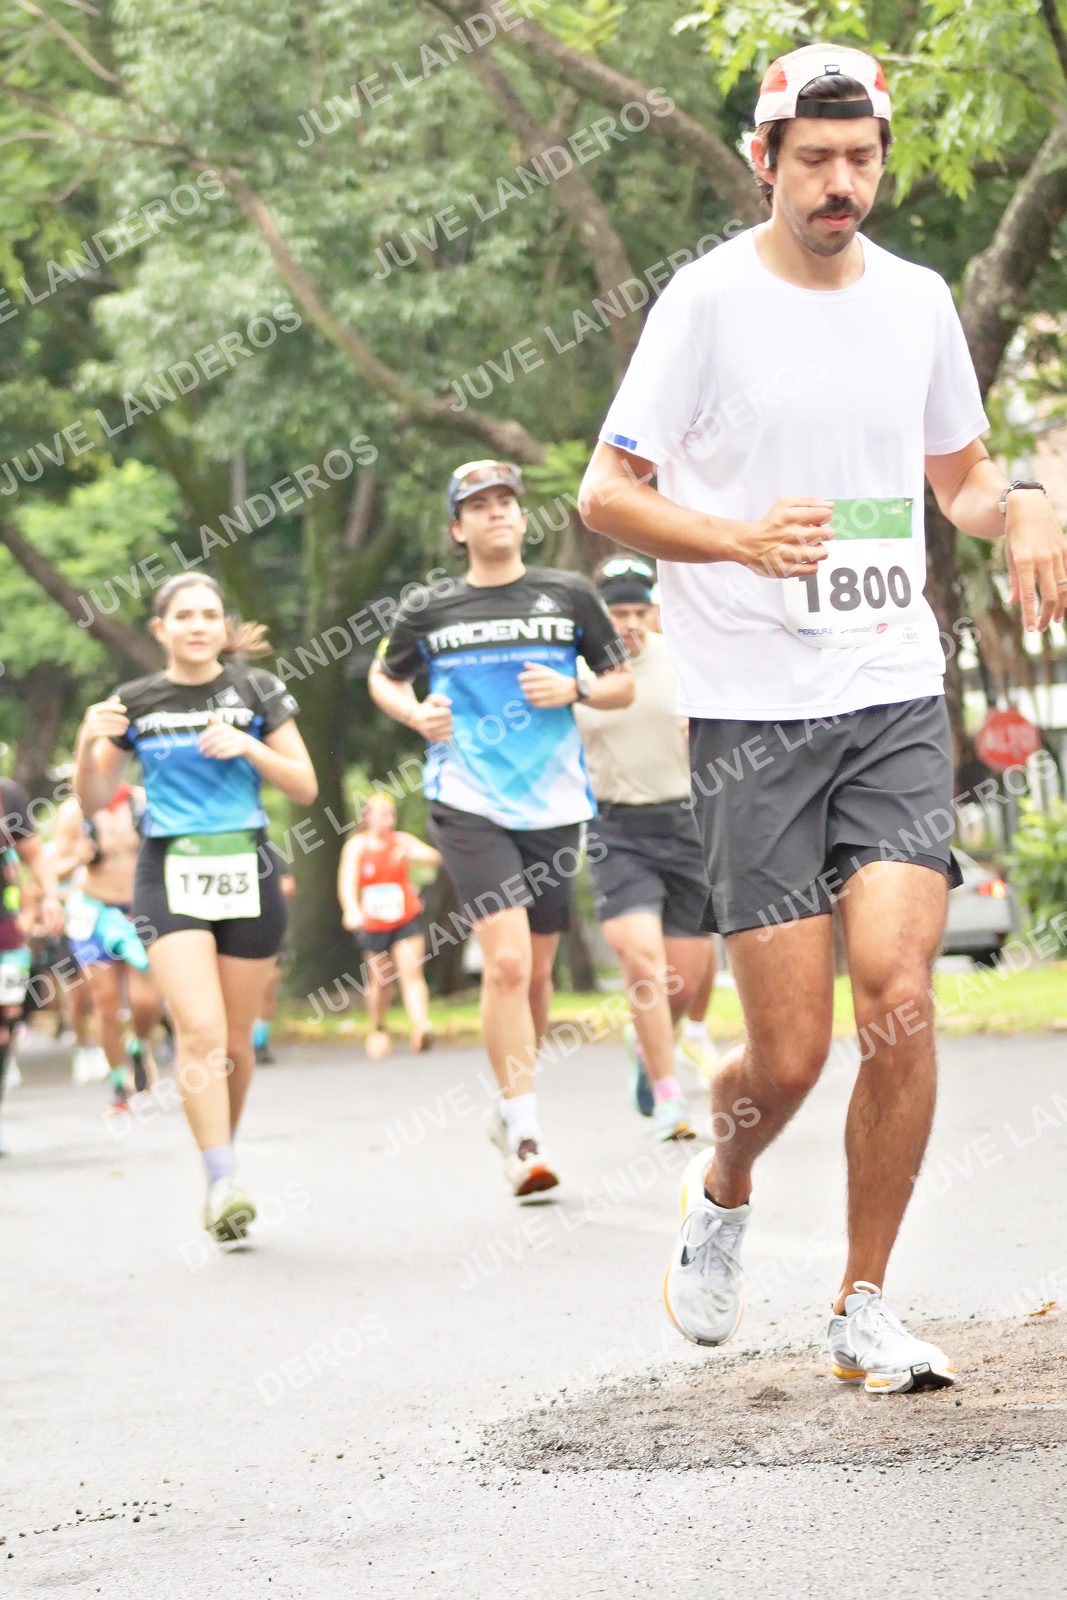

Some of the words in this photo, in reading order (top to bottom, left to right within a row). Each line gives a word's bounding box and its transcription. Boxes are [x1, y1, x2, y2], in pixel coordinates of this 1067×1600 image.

[799, 565, 912, 613] 1800
[427, 616, 575, 653] TRIDENTE
[180, 872, 250, 896] 1783
